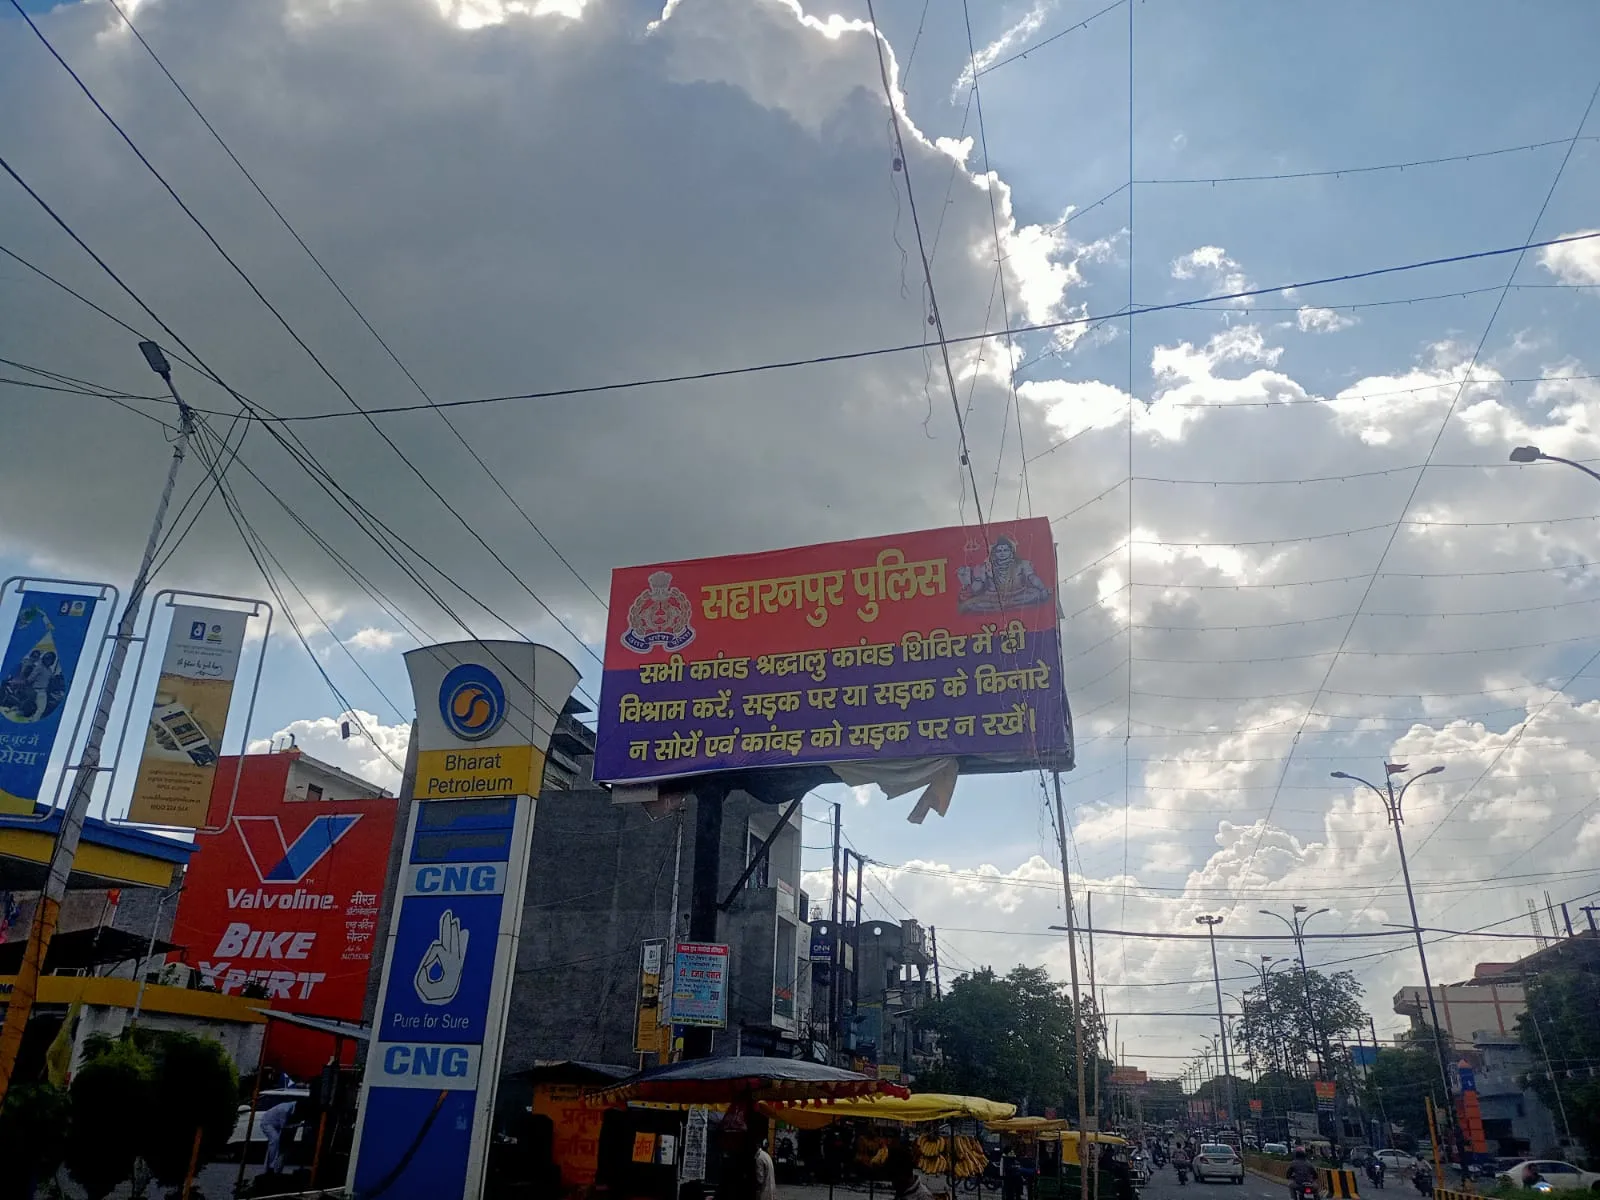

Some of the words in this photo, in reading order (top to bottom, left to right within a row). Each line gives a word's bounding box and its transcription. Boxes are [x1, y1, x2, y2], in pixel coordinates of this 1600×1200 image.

[702, 571, 846, 627] सहारनपुर
[852, 549, 947, 622] पुलिस
[639, 654, 684, 683] सभी
[690, 651, 750, 680] कांवड
[757, 646, 826, 682] श्रद्धालु
[833, 638, 894, 667] कांवड
[901, 628, 967, 661] शिविर
[972, 625, 997, 655] में
[1001, 620, 1025, 655] ही
[620, 691, 687, 723] विश्राम
[692, 688, 735, 721] करें,
[743, 689, 800, 722] सड़क
[807, 685, 837, 711] पर
[843, 681, 867, 708] या
[873, 678, 936, 710] सड़क
[943, 669, 968, 698] के
[975, 660, 1051, 695] किनारे
[629, 741, 647, 761] न
[655, 725, 703, 761] सोयें
[704, 727, 740, 757] एवं
[742, 723, 804, 756] कांवड़
[811, 720, 843, 748] को
[849, 714, 909, 751] सड़क
[918, 713, 948, 741] पर
[955, 712, 975, 736] न
[0, 745, 38, 765] रोसा
[445, 753, 502, 771] Bharat
[428, 776, 513, 794] Petroleum
[415, 866, 496, 892] CNG
[227, 888, 334, 909] Valvoline
[350, 891, 377, 906] नीरज
[213, 922, 316, 960] BIKE
[393, 1013, 420, 1028] Pure
[423, 1013, 439, 1028] for
[442, 1013, 470, 1029] Sure
[384, 1045, 468, 1077] CNG
